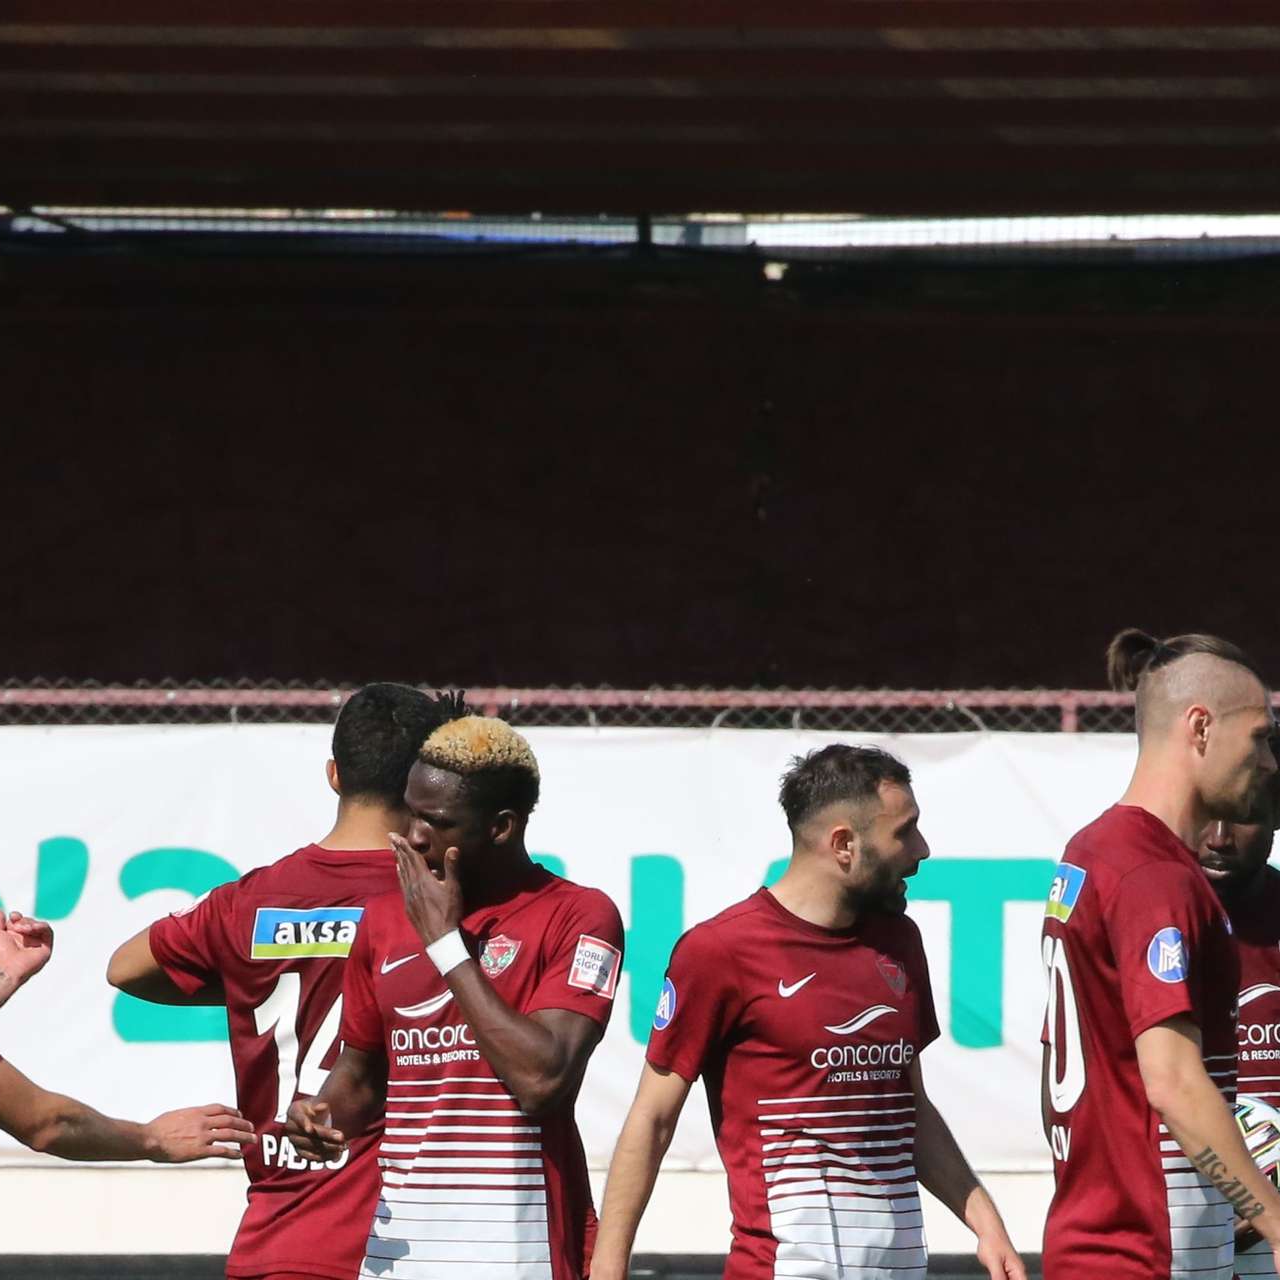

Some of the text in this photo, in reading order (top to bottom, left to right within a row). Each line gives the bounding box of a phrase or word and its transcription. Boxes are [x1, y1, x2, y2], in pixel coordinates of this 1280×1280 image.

[275, 920, 358, 944] aksa
[396, 1053, 431, 1067] HOTELS
[432, 1052, 441, 1064] &
[811, 1037, 914, 1069] concorde
[1241, 1050, 1250, 1061] &
[827, 1071, 861, 1083] HOTELS
